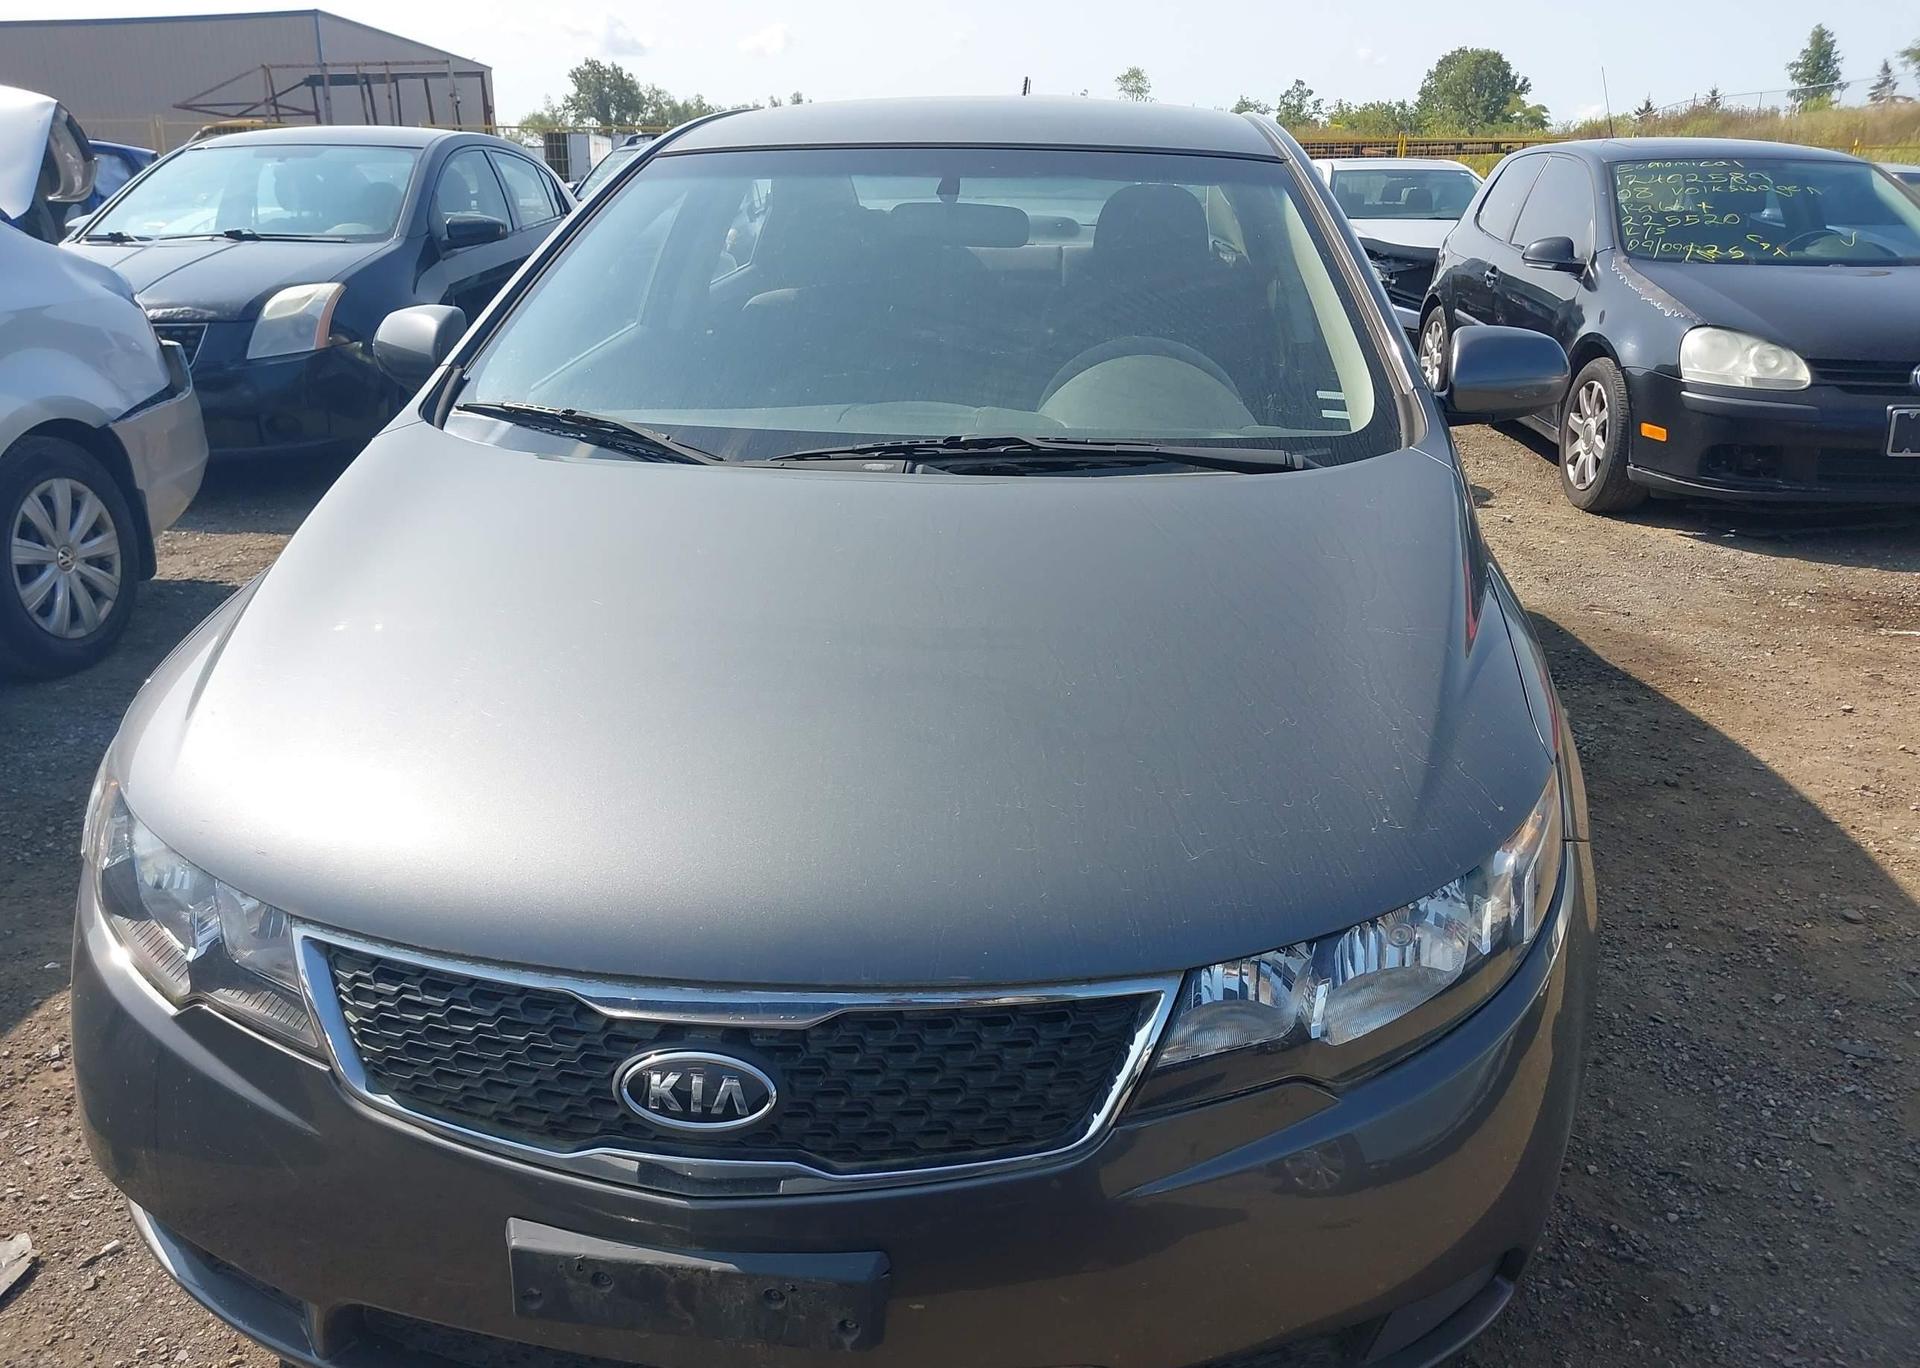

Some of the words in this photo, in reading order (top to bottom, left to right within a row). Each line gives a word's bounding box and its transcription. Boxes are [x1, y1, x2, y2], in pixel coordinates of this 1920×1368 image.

[1617, 187, 1654, 201] 08
[1622, 214, 1741, 227] 225520
[647, 1070, 750, 1116] KIA
